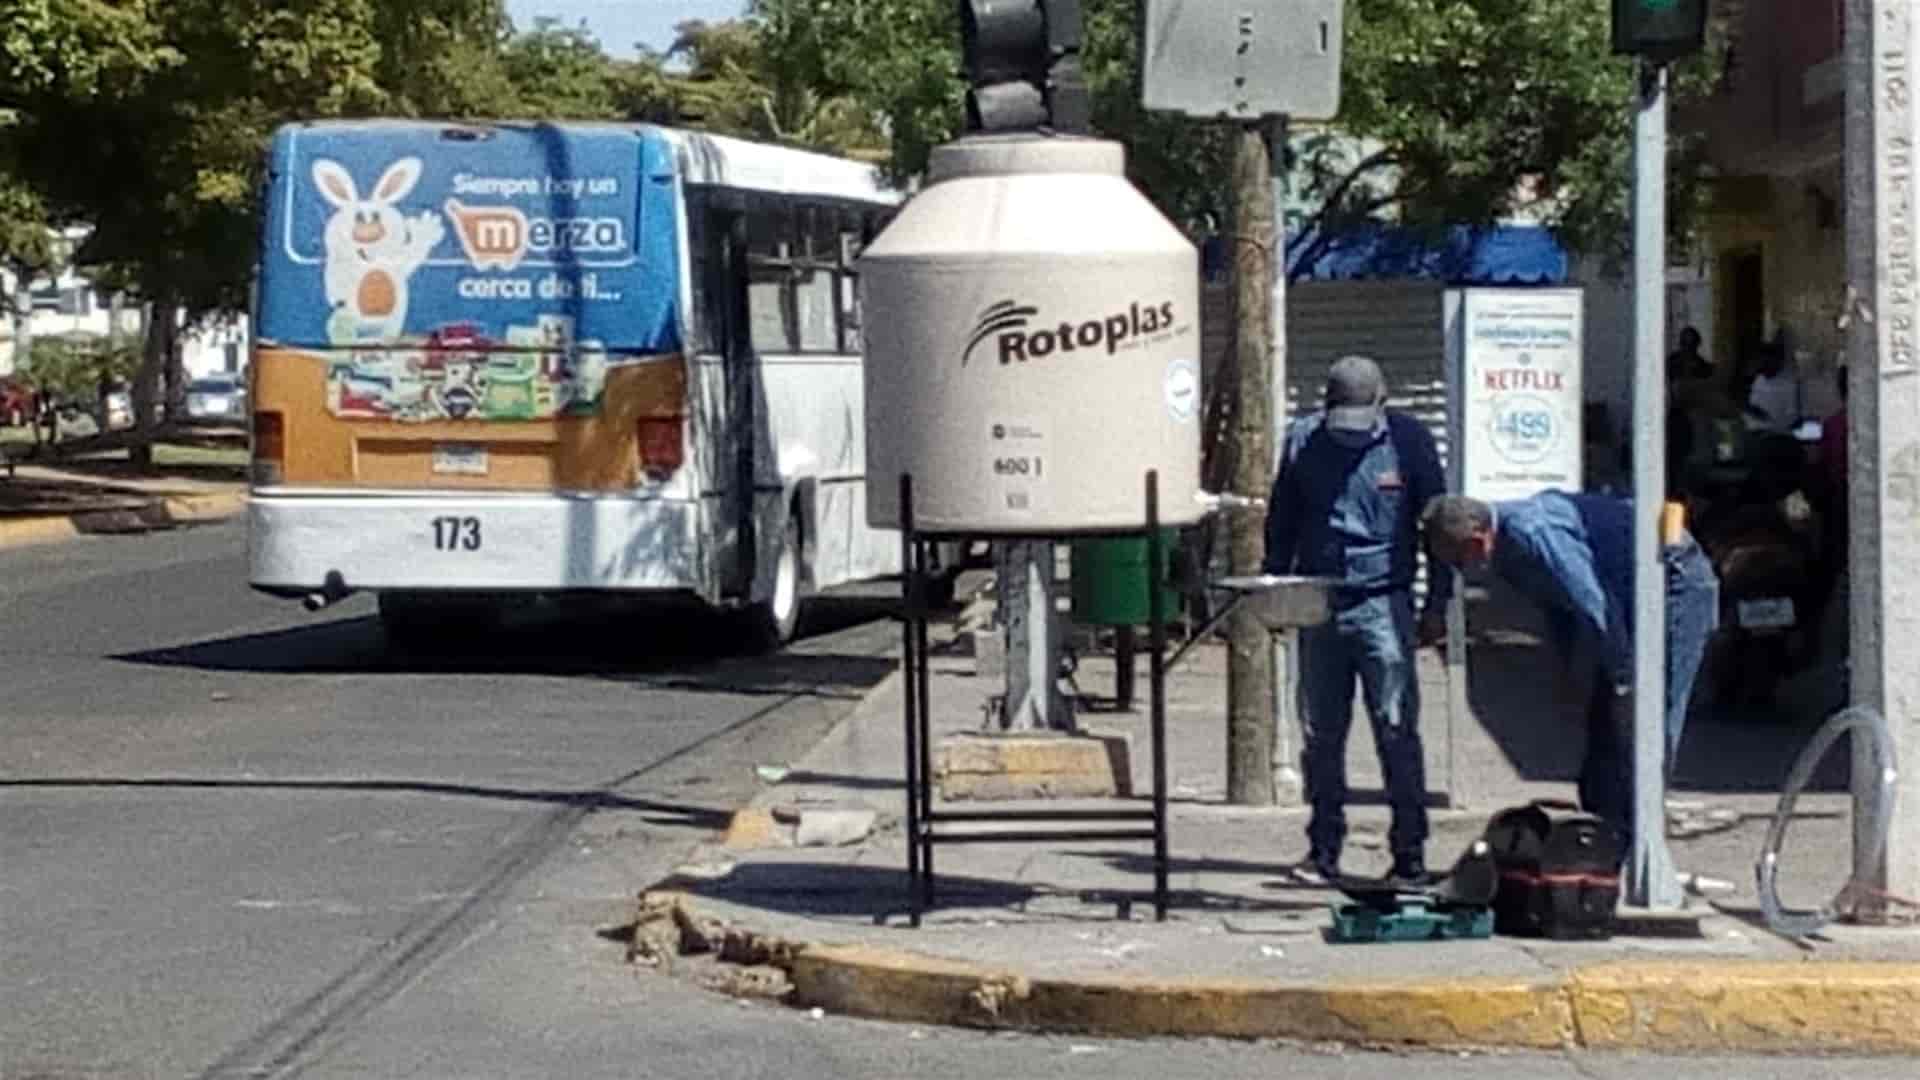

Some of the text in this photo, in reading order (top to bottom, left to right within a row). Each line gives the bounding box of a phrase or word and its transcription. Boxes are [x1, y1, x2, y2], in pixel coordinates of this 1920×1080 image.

[453, 174, 539, 198] Siempre
[589, 178, 618, 194] un
[475, 217, 622, 251] merza
[459, 277, 531, 298] cerca
[538, 273, 573, 298] de
[997, 301, 1175, 364] Rotoplas
[1485, 369, 1563, 391] NETFLIX
[432, 516, 481, 551] 173
